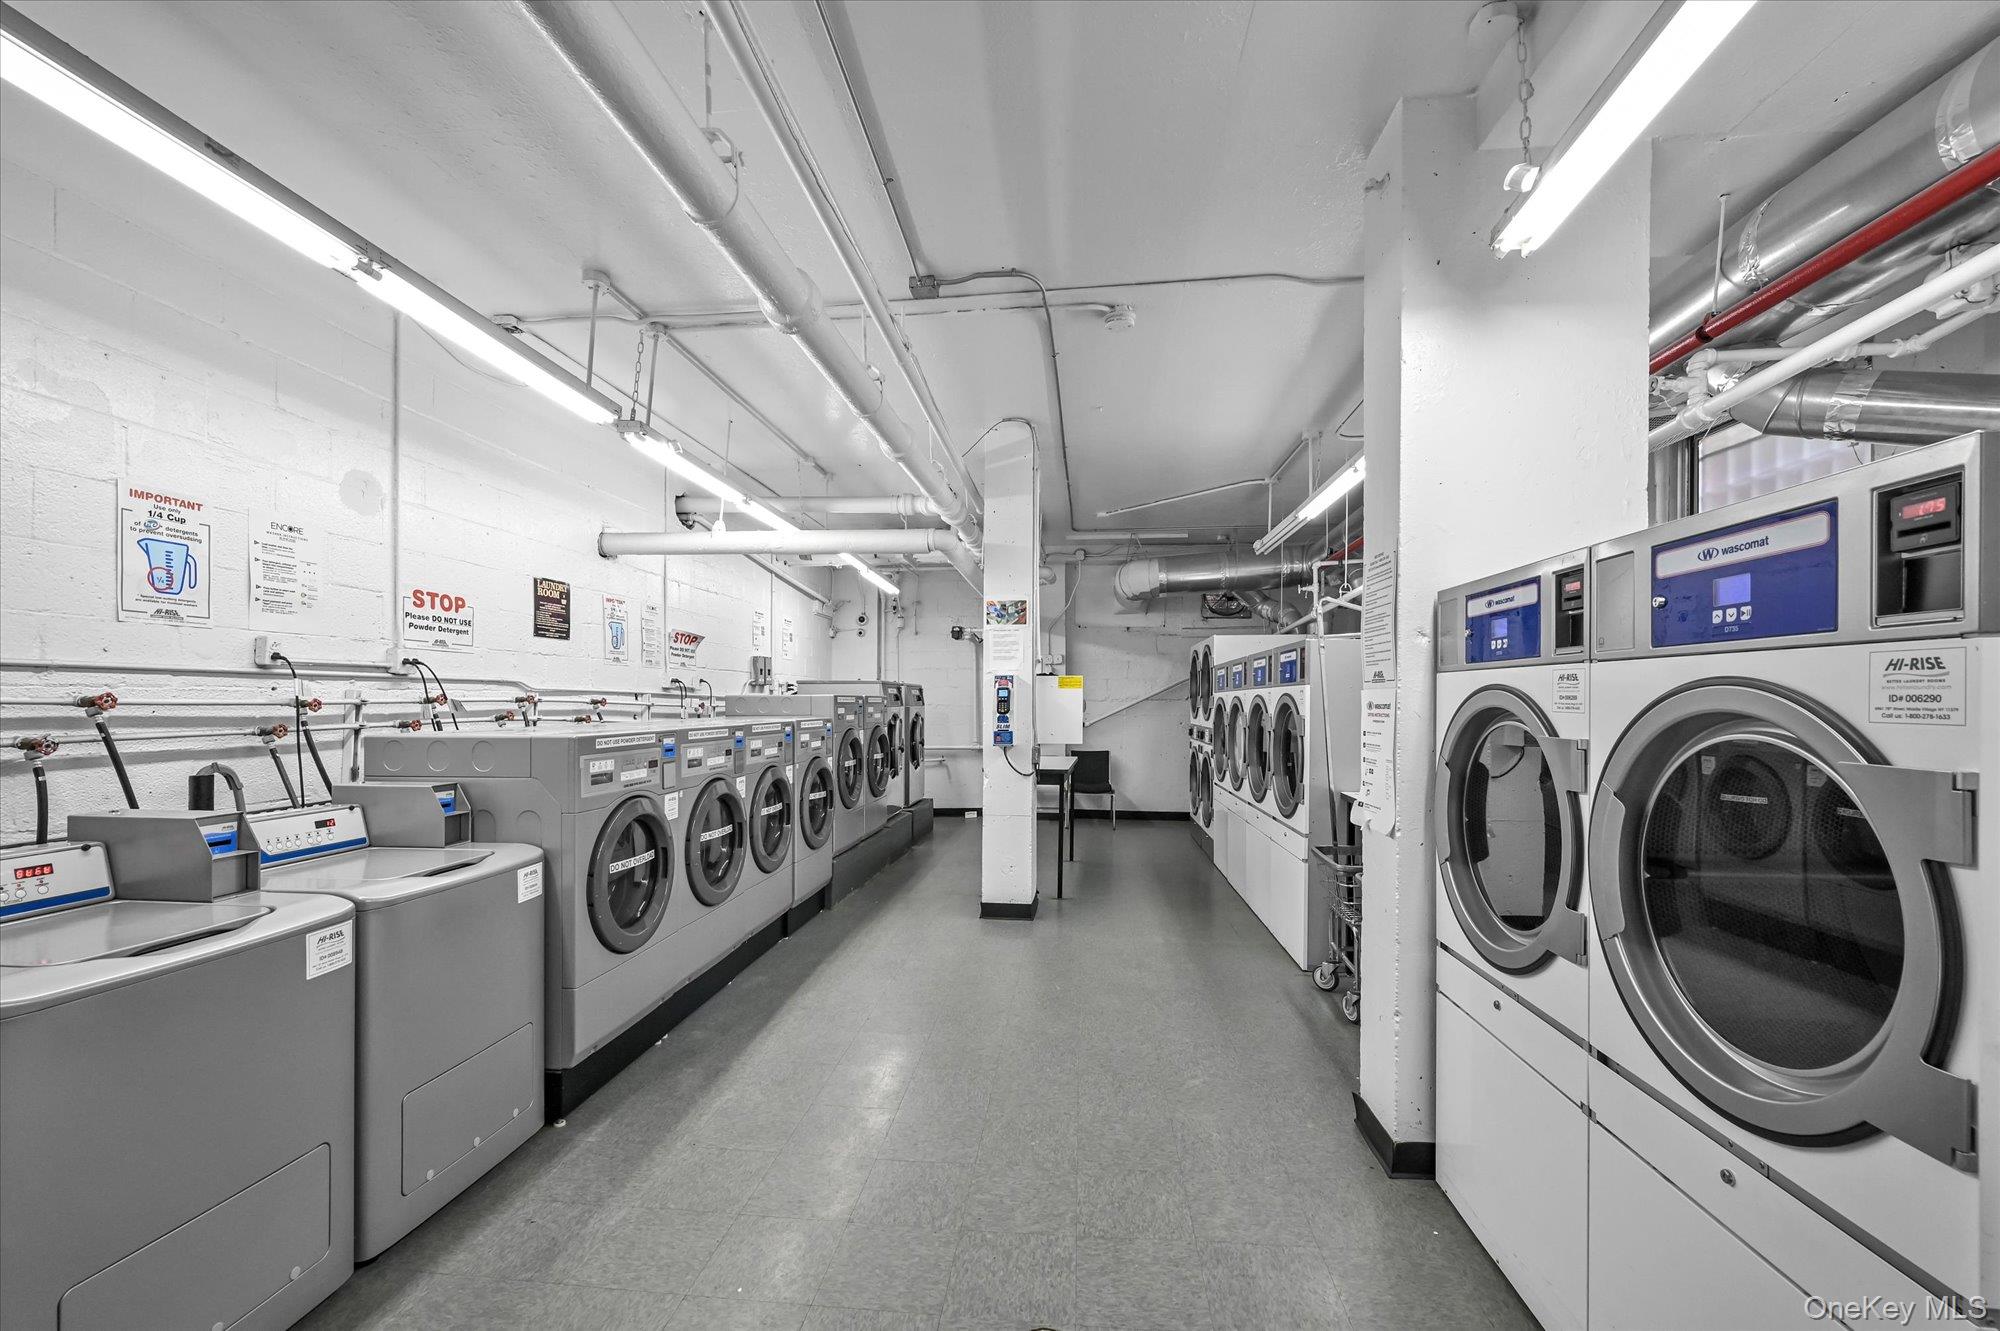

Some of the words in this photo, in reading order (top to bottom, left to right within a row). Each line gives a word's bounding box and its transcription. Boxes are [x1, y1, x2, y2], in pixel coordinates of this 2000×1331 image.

[129, 488, 203, 511] IMPORTANT
[153, 503, 166, 511] Use
[148, 510, 163, 519] 1/4
[167, 513, 187, 524] Cup
[165, 527, 198, 537] detergents
[271, 522, 304, 535] ENCORE
[139, 529, 164, 537] prevent
[165, 532, 203, 544] oversudsing
[1721, 536, 1769, 556] wascomat
[537, 580, 567, 593] LAUNDRY
[537, 587, 560, 599] ROOM
[412, 589, 466, 613] STOP
[405, 612, 430, 621] Please
[444, 617, 457, 625] NOT
[459, 619, 472, 627] USE
[408, 622, 436, 632] Powder
[438, 626, 469, 636] Detergent
[673, 632, 698, 645] STOP
[1885, 656, 1946, 672] HI-RISE
[1888, 694, 1904, 703] ID#
[1905, 694, 1942, 703] 006290
[610, 864, 619, 872] DO
[620, 860, 632, 868] NOT
[632, 851, 655, 865] OVERLOAD
[317, 930, 344, 945] HI-RISE
